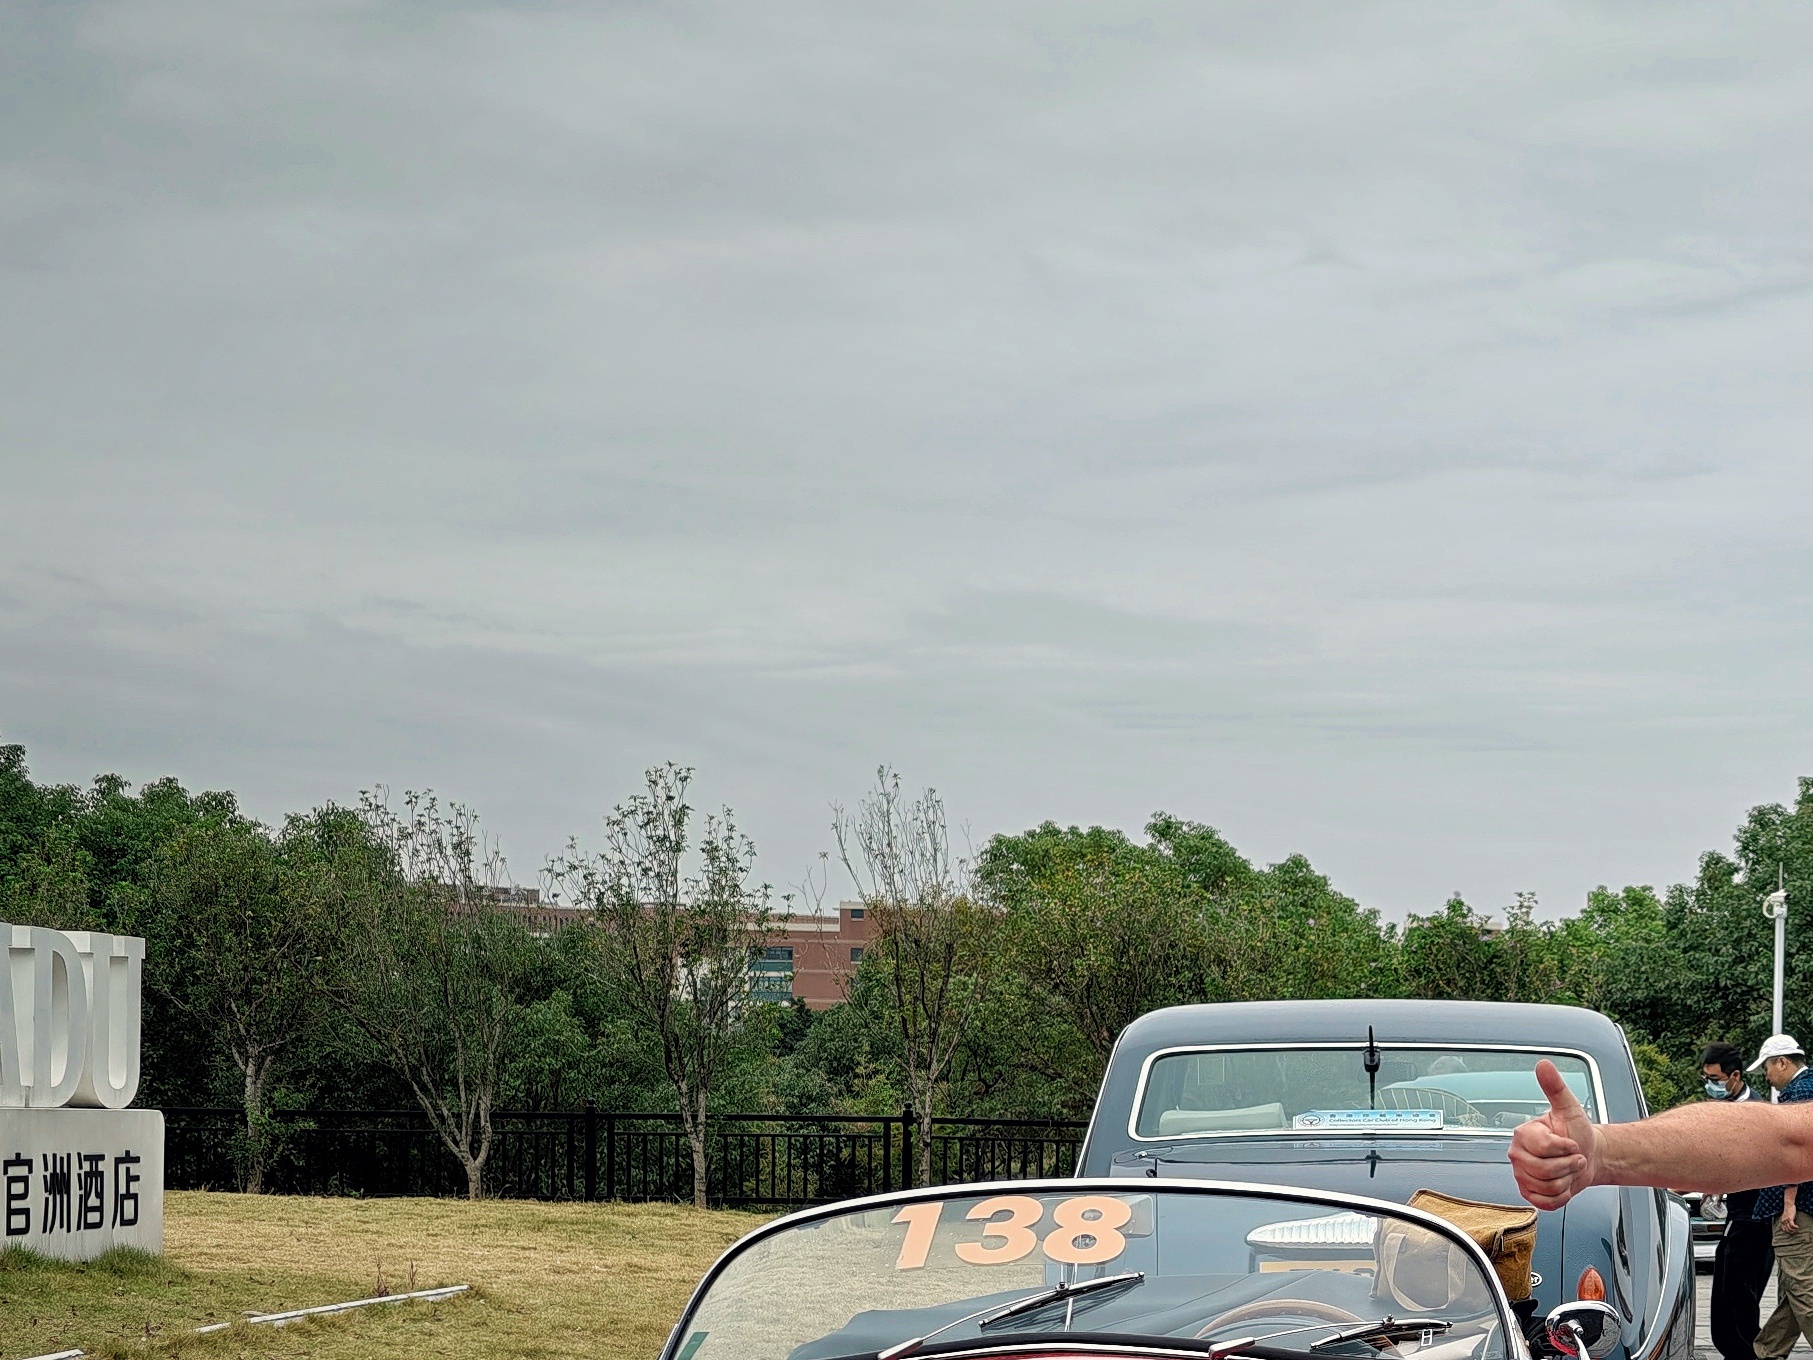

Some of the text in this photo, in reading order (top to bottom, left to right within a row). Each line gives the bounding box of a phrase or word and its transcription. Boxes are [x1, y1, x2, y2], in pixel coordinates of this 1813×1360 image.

[3, 1150, 141, 1236] 官洲酒店
[890, 1195, 1132, 1270] 138
